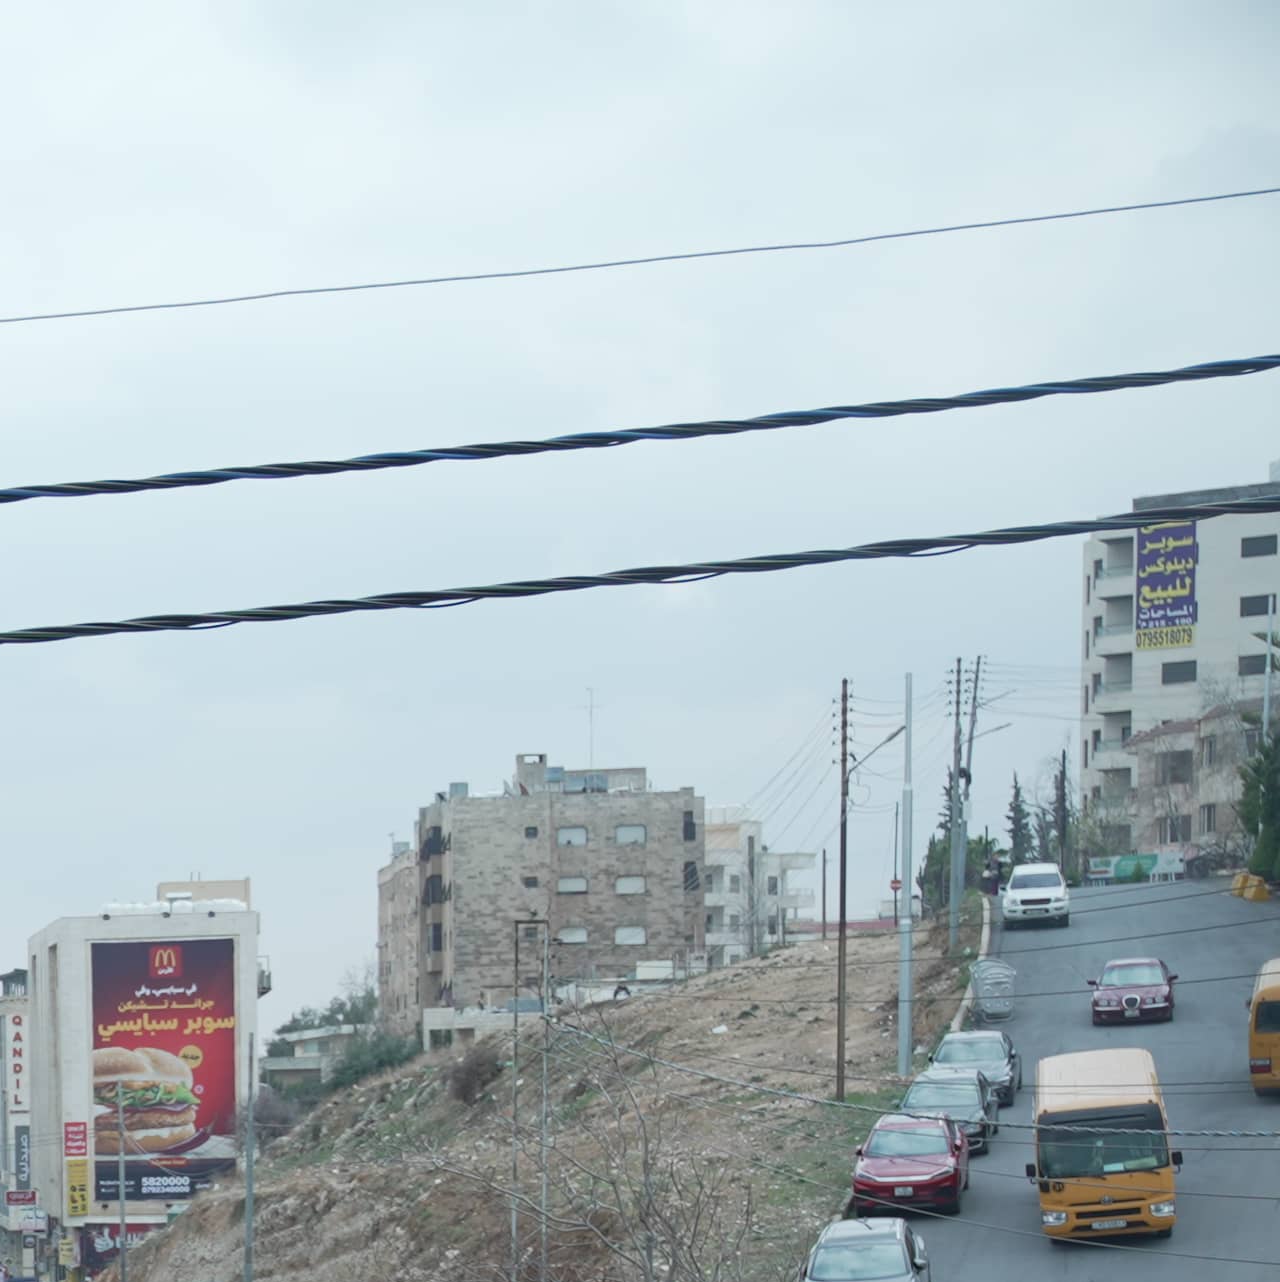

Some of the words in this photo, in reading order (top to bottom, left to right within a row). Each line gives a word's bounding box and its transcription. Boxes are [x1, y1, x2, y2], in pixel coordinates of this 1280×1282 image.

[1141, 536, 1194, 554] سوبر
[1139, 556, 1194, 578] ديلوكس
[1139, 576, 1192, 608] للبيع
[98, 1012, 179, 1042] سبايسي
[183, 1015, 236, 1036] سوبر
[11, 1015, 23, 1105] QANDIL
[141, 1176, 190, 1186] 5820000
